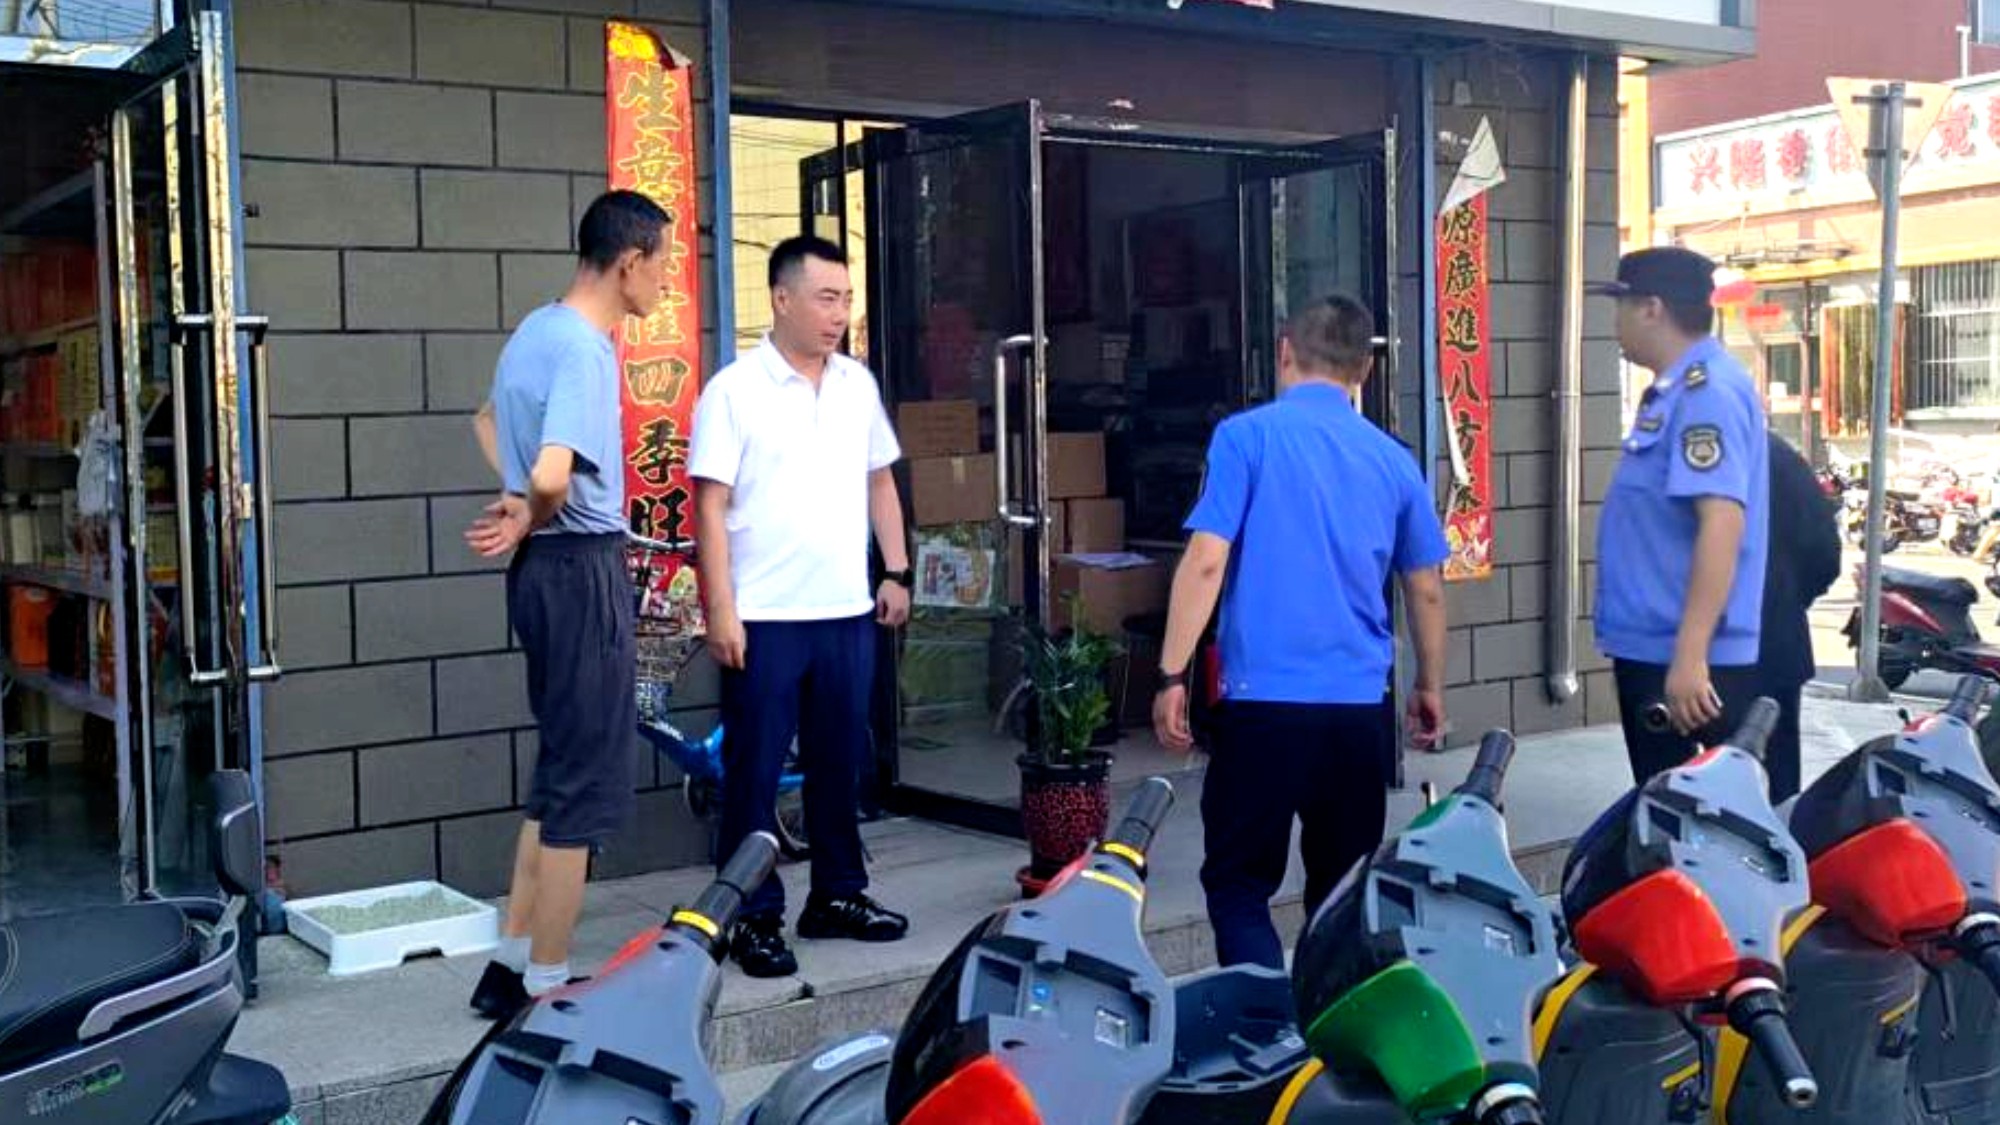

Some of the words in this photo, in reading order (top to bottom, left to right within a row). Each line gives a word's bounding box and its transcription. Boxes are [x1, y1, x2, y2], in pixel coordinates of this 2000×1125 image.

[617, 61, 691, 545] 生意隆四季旺
